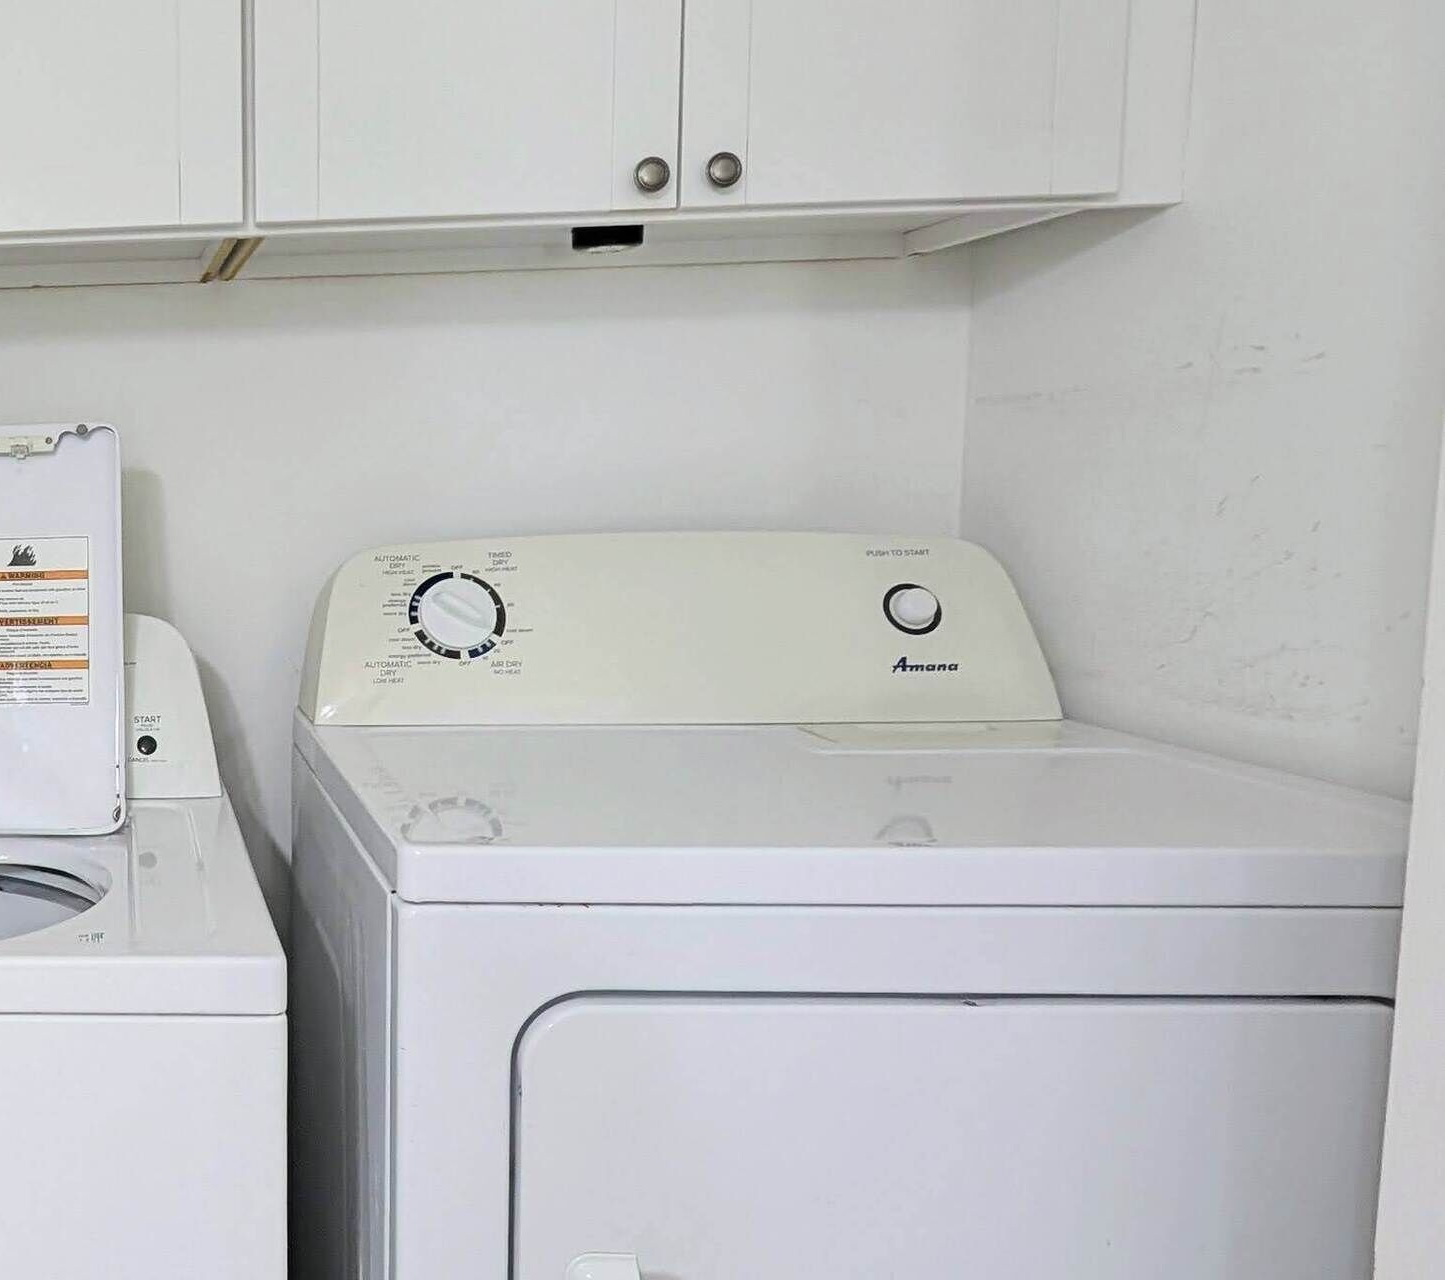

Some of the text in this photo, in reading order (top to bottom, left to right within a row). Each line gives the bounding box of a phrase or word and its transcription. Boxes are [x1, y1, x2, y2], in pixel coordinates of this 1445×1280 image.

[488, 551, 512, 559] TIMED
[866, 549, 889, 557] PUSH
[904, 548, 930, 556] START
[374, 554, 420, 562] AUTOMATIC
[8, 571, 45, 579] WARNING
[365, 660, 412, 668] AUTOMATIC
[892, 656, 958, 673] Amana
[380, 669, 397, 677] DRY
[134, 715, 161, 723] START
